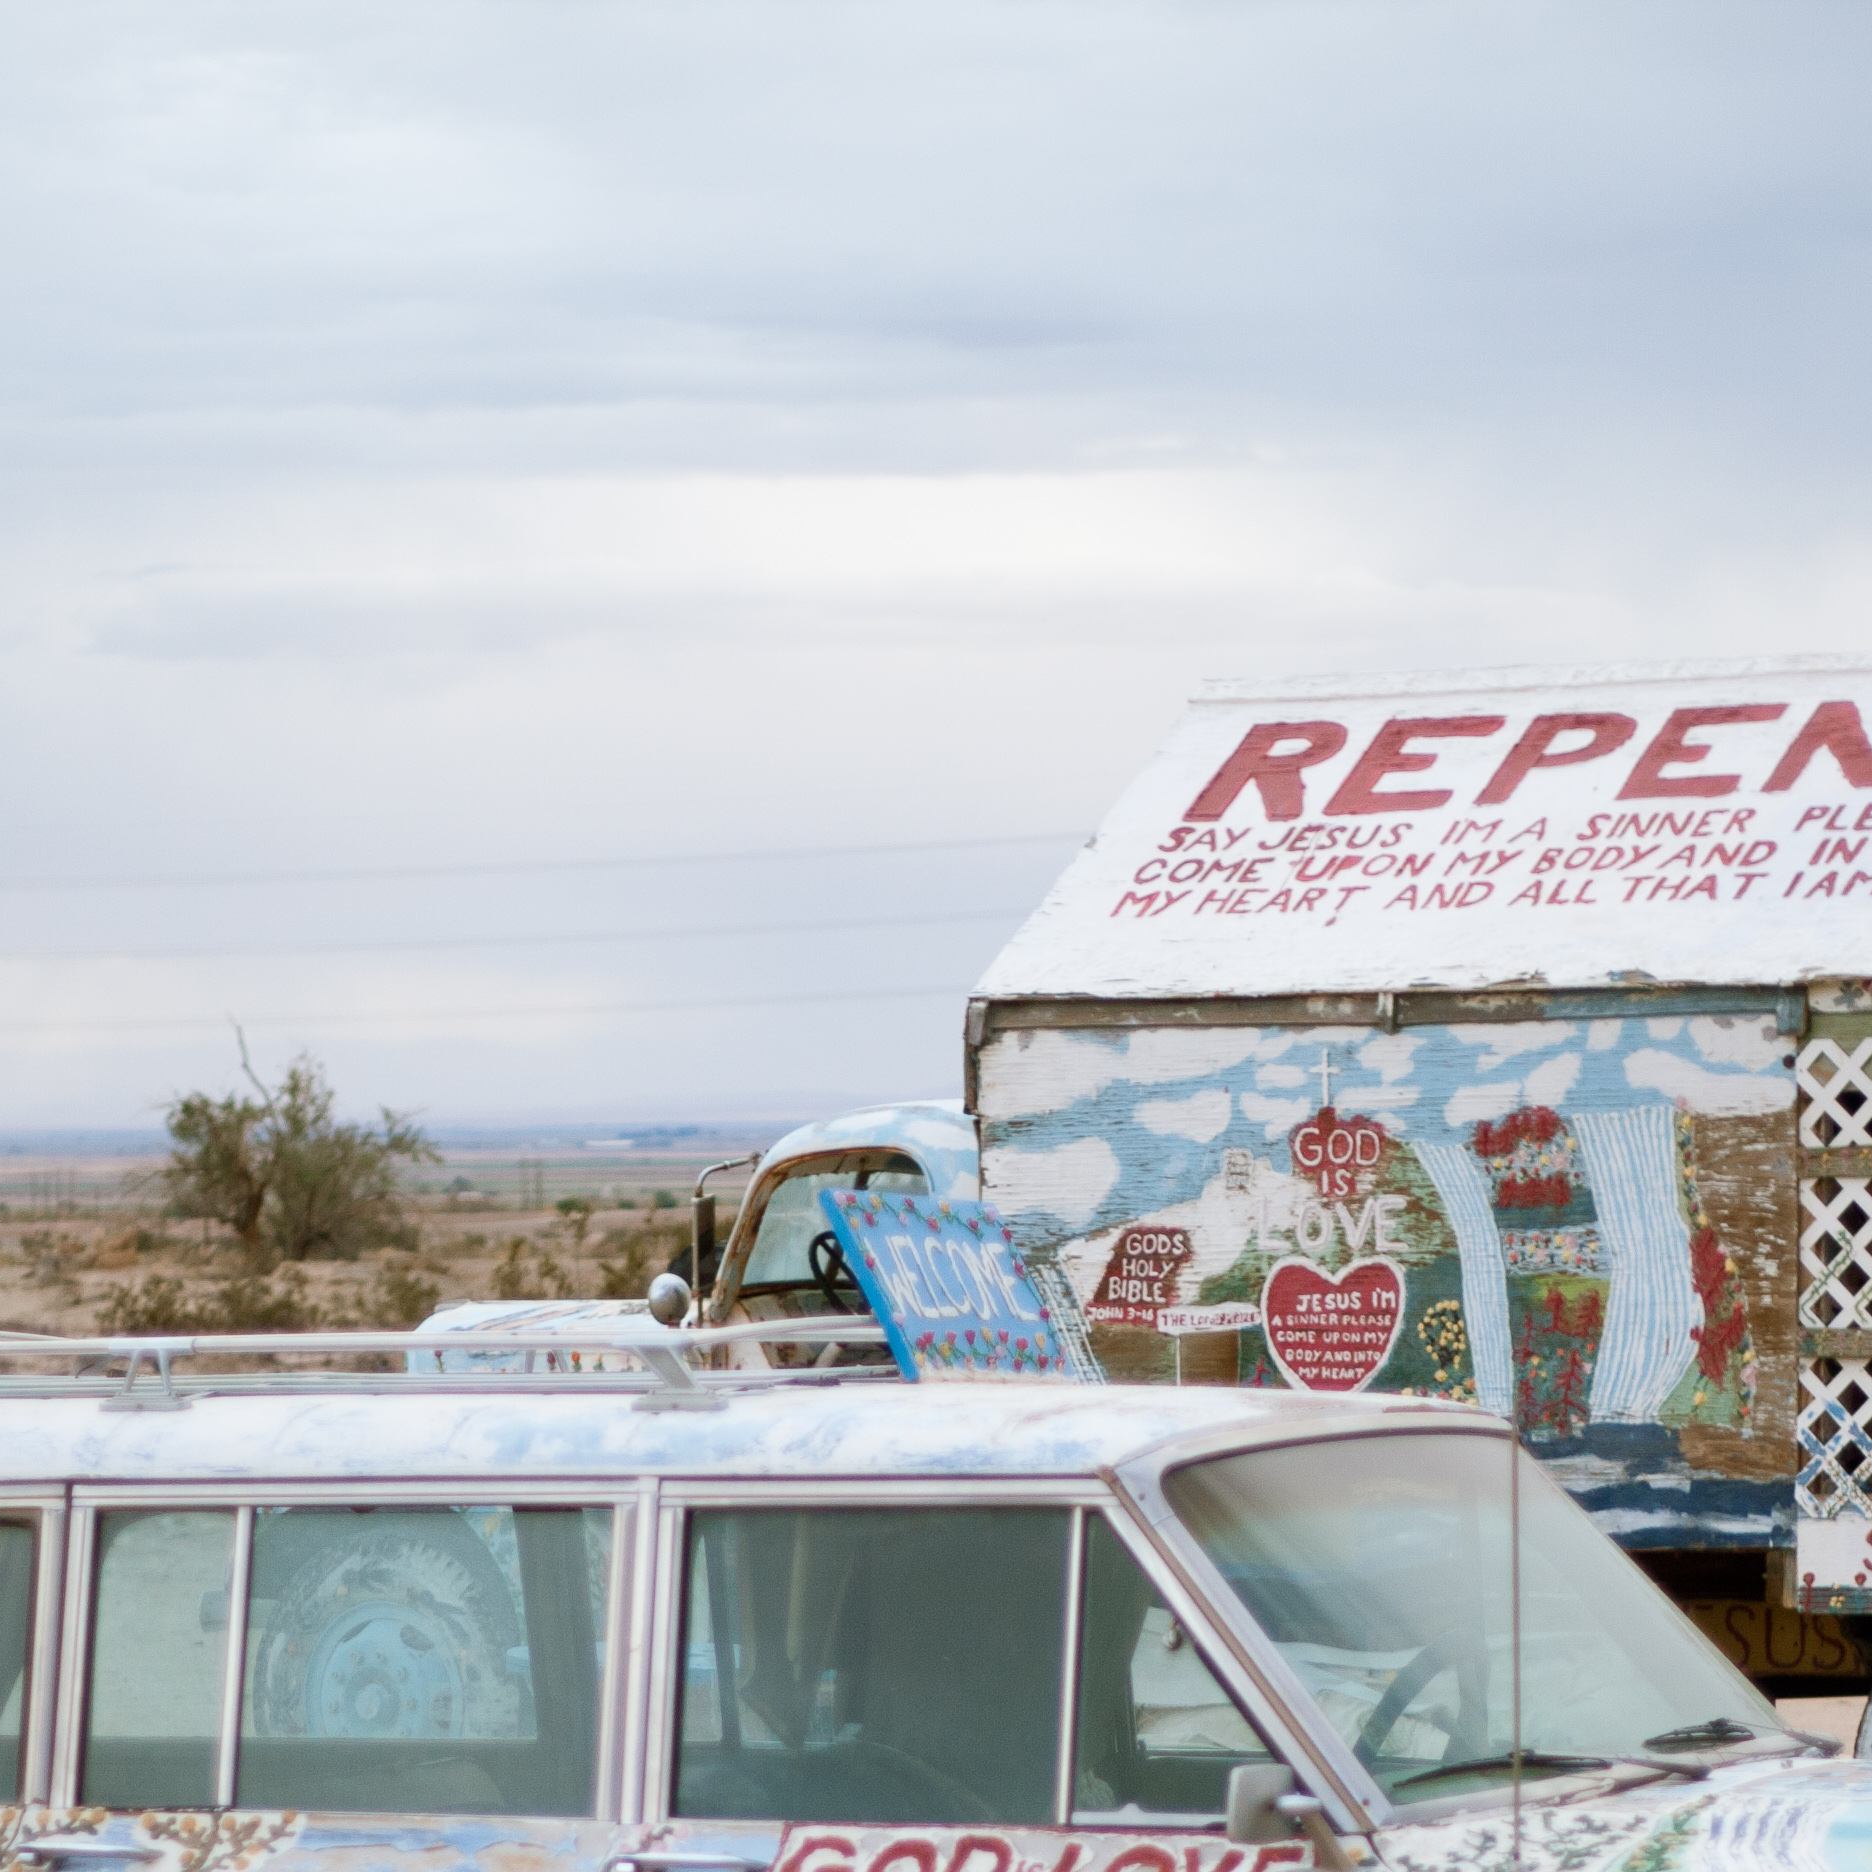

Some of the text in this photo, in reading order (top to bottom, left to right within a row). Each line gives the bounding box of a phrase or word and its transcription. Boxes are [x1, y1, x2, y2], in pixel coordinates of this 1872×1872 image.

[1158, 827, 1250, 853] SAY
[1258, 823, 1413, 854] JESUS
[1509, 818, 1547, 843] A
[1577, 808, 1756, 842] SINNER
[1134, 858, 1275, 885] COME
[1294, 852, 1434, 882] UPON
[1443, 849, 1524, 877] MY
[1530, 844, 1661, 874] BODY
[1658, 840, 1778, 869] AND
[1109, 890, 1192, 918] MY
[1384, 881, 1496, 911] AND
[1508, 879, 1596, 906] ALL
[1623, 872, 1768, 901] THAT
[1783, 871, 1805, 898] I
[1294, 1126, 1381, 1167] GOD
[1321, 1168, 1352, 1196] IS
[1257, 1194, 1410, 1251] LOVE
[865, 1233, 1039, 1323] WELCOME
[1121, 1257, 1175, 1279] HOLY
[1108, 1276, 1167, 1304] BIBLE
[1296, 1291, 1362, 1312] JESUS
[1087, 1306, 1124, 1322] JOHN
[1271, 1314, 1283, 1326] A
[1286, 1313, 1339, 1326] SINNER
[1342, 1314, 1392, 1326] PLEASE
[1276, 1331, 1316, 1344] COME
[1364, 1331, 1388, 1345] MY
[1285, 1349, 1383, 1363] BODY AND INTO
[1298, 1366, 1366, 1380] MY HEART
